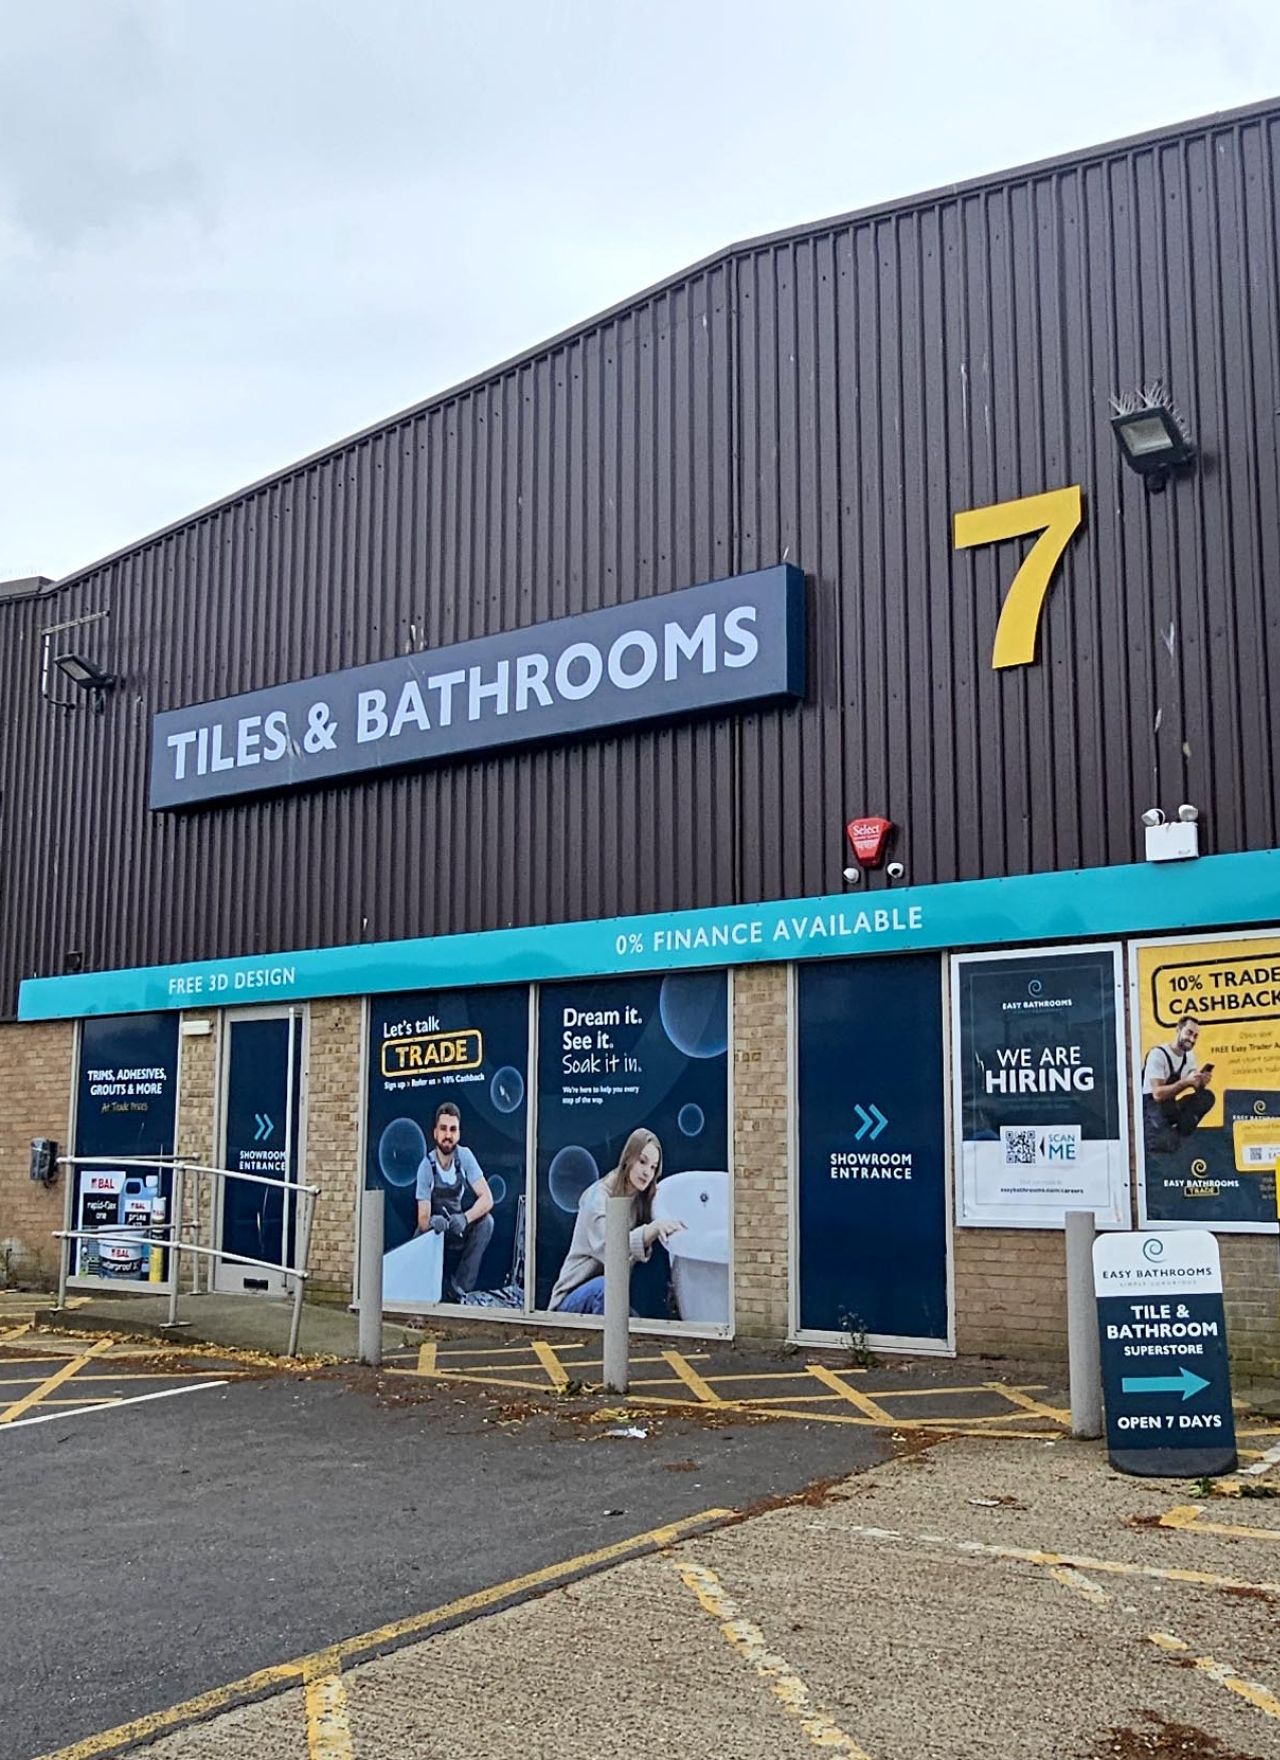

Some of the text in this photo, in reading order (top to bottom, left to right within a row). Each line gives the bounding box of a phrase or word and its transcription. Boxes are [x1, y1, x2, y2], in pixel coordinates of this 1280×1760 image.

[955, 485, 1081, 669] 7
[167, 607, 759, 780] TILES & BATHROOMS
[853, 824, 880, 836] Select
[616, 906, 923, 955] 0% FINANCE AVAILABLE
[169, 967, 295, 995] FREE 3D DESIGN
[1168, 974, 1203, 992] 10%
[1002, 1002, 1021, 1010] EASY
[1023, 999, 1073, 1009] BATHROOMS
[563, 1005, 643, 1027] Dream it.
[383, 1015, 440, 1038] Let's talk
[562, 1031, 614, 1050] See it.
[395, 1039, 468, 1068] TRADE
[1211, 1045, 1229, 1053] FREE
[562, 1053, 642, 1074] Soak it in.
[997, 1046, 1081, 1068] WE ARE
[87, 1067, 167, 1082] TRIMS, ADHESIVES,
[455, 1072, 485, 1083] Cashback
[986, 1067, 1094, 1093] HIRING
[90, 1083, 162, 1095] GROUTS & MORE
[1049, 1133, 1075, 1142] SCAN
[240, 1150, 286, 1160] SHOWROOM
[1049, 1144, 1076, 1160] ME
[239, 1161, 286, 1171] ENTRANCE
[830, 1153, 912, 1167] SHOWROOM
[830, 1167, 912, 1180] ENTRANCE
[1163, 1179, 1240, 1187] EASY BATHROOMS
[1102, 1267, 1213, 1279] EASY BATHROOMS
[1130, 1304, 1190, 1320] TILE &
[1106, 1322, 1218, 1340] BATHROOM
[1124, 1344, 1204, 1356] SUPERSTORE
[1117, 1414, 1222, 1429] OPEN 7 DAYS
